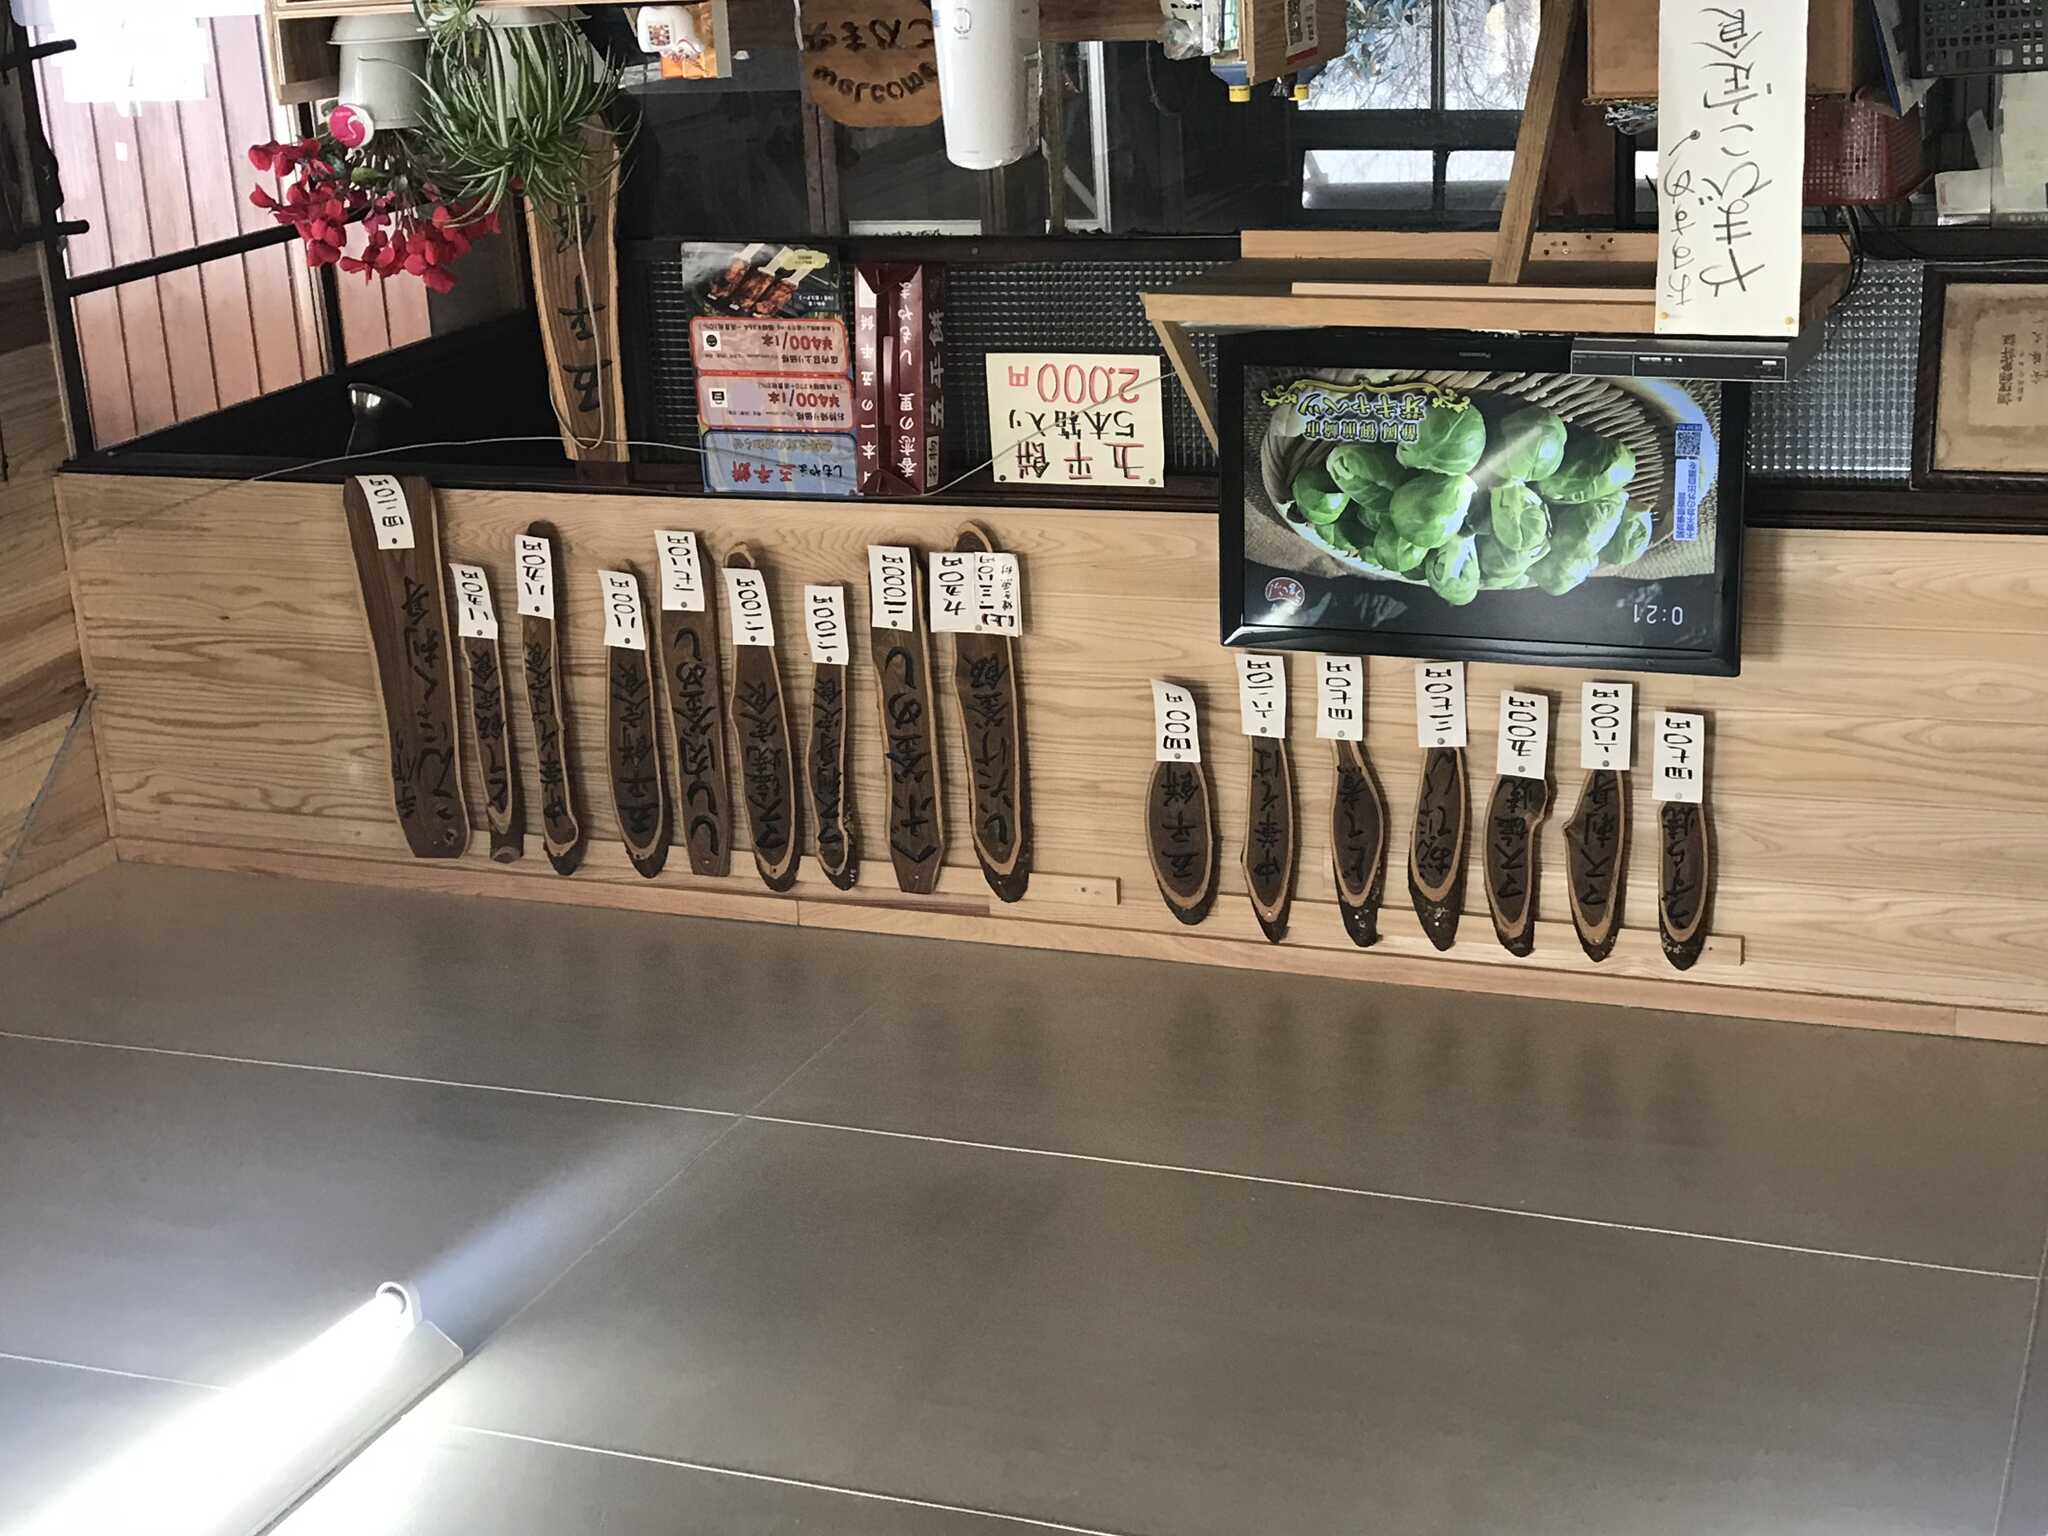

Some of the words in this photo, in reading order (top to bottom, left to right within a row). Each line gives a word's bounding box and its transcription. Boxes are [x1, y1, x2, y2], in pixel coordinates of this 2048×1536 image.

[1009, 409, 1134, 439] 5本箱入り
[1016, 441, 1144, 480] 五平餅
[1297, 392, 1425, 420] 芽キャベツ
[1303, 420, 1376, 441] 御前崎市
[1380, 422, 1418, 441] 静岡
[1633, 603, 1684, 626] 0:21
[672, 628, 720, 855] しし肉釜めし
[962, 655, 1012, 845] しいたけ釜飯
[1161, 763, 1200, 879] 五平餅
[1253, 750, 1280, 882] 中華そば
[1337, 766, 1366, 881] どて煮
[1494, 780, 1535, 898] マス塩焼
[1581, 770, 1616, 905] マス刺身
[1662, 806, 1698, 920] うずら焼
